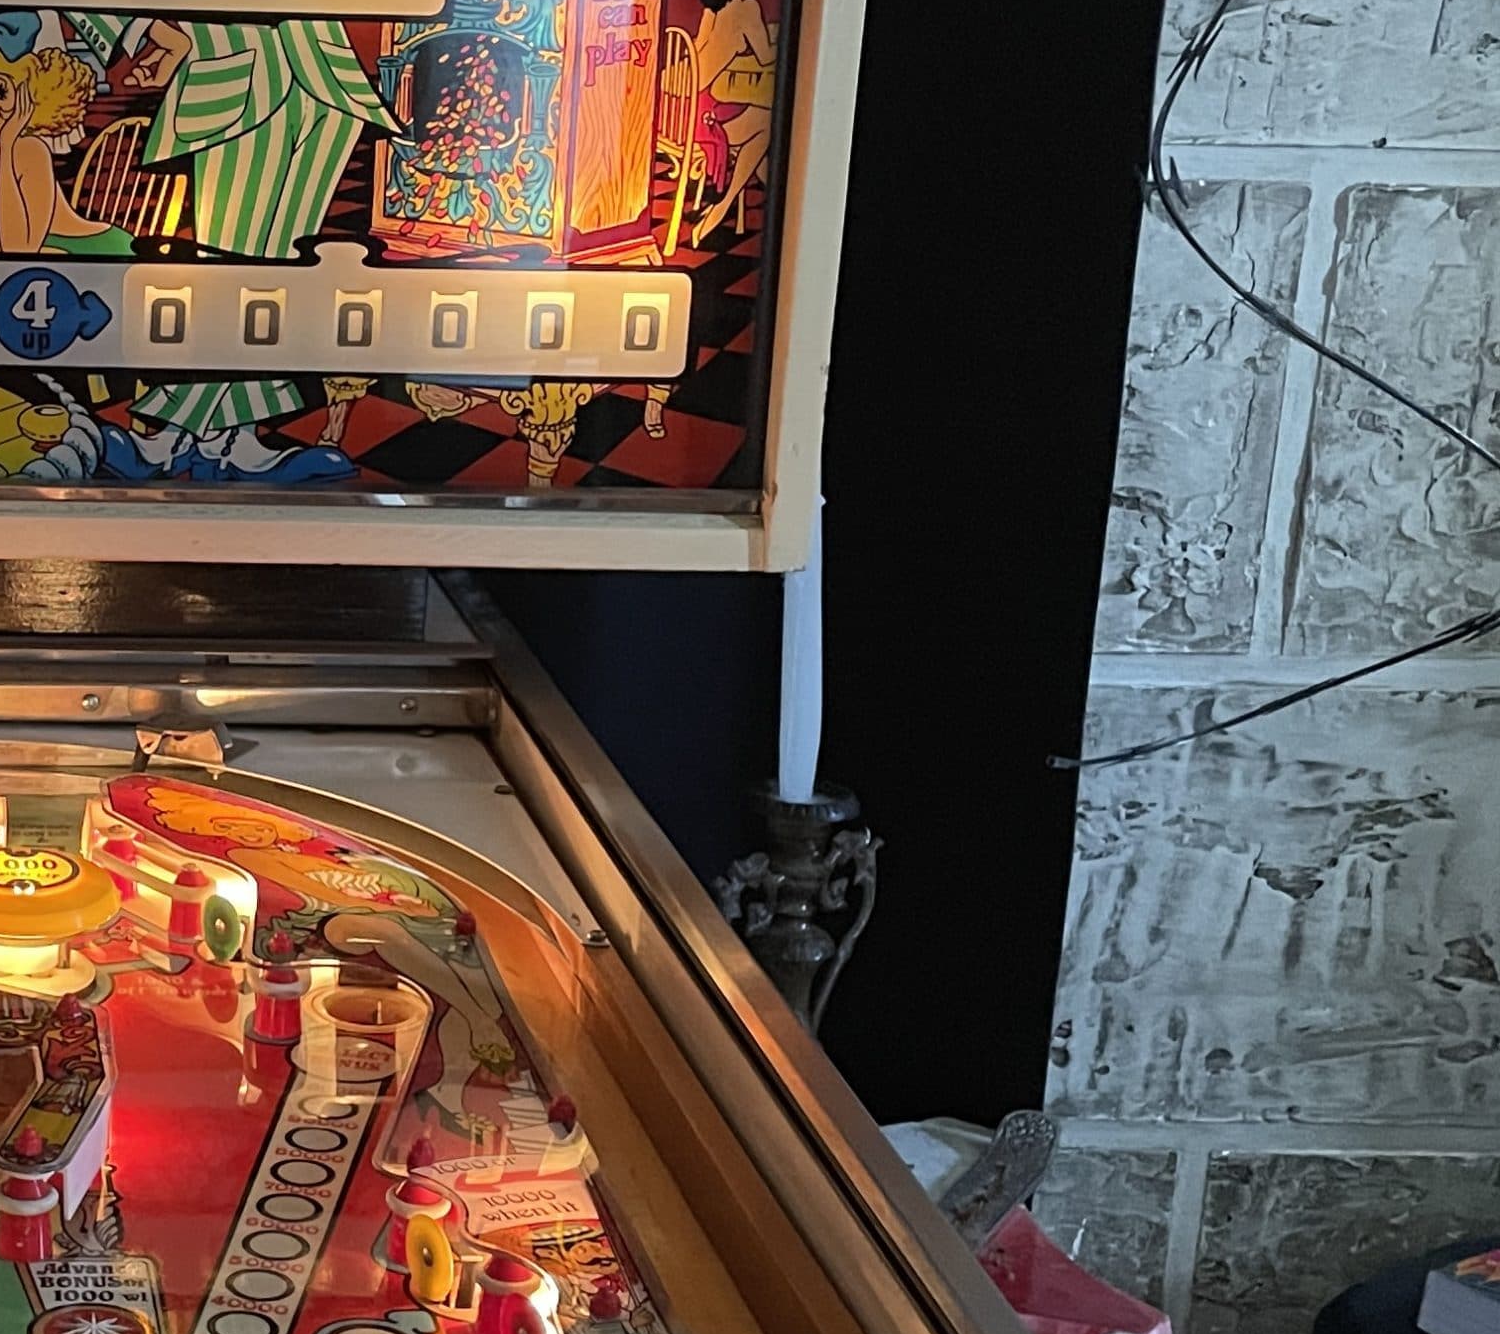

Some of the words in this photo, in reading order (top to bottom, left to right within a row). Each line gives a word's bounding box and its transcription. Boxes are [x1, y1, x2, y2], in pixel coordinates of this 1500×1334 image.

[597, 3, 648, 29] can
[584, 31, 653, 87] play
[483, 1187, 558, 1208] 10000
[481, 1205, 547, 1223] when
[551, 1199, 580, 1214] lit
[38, 1275, 121, 1289] BONUS
[54, 1289, 115, 1302] 1000
